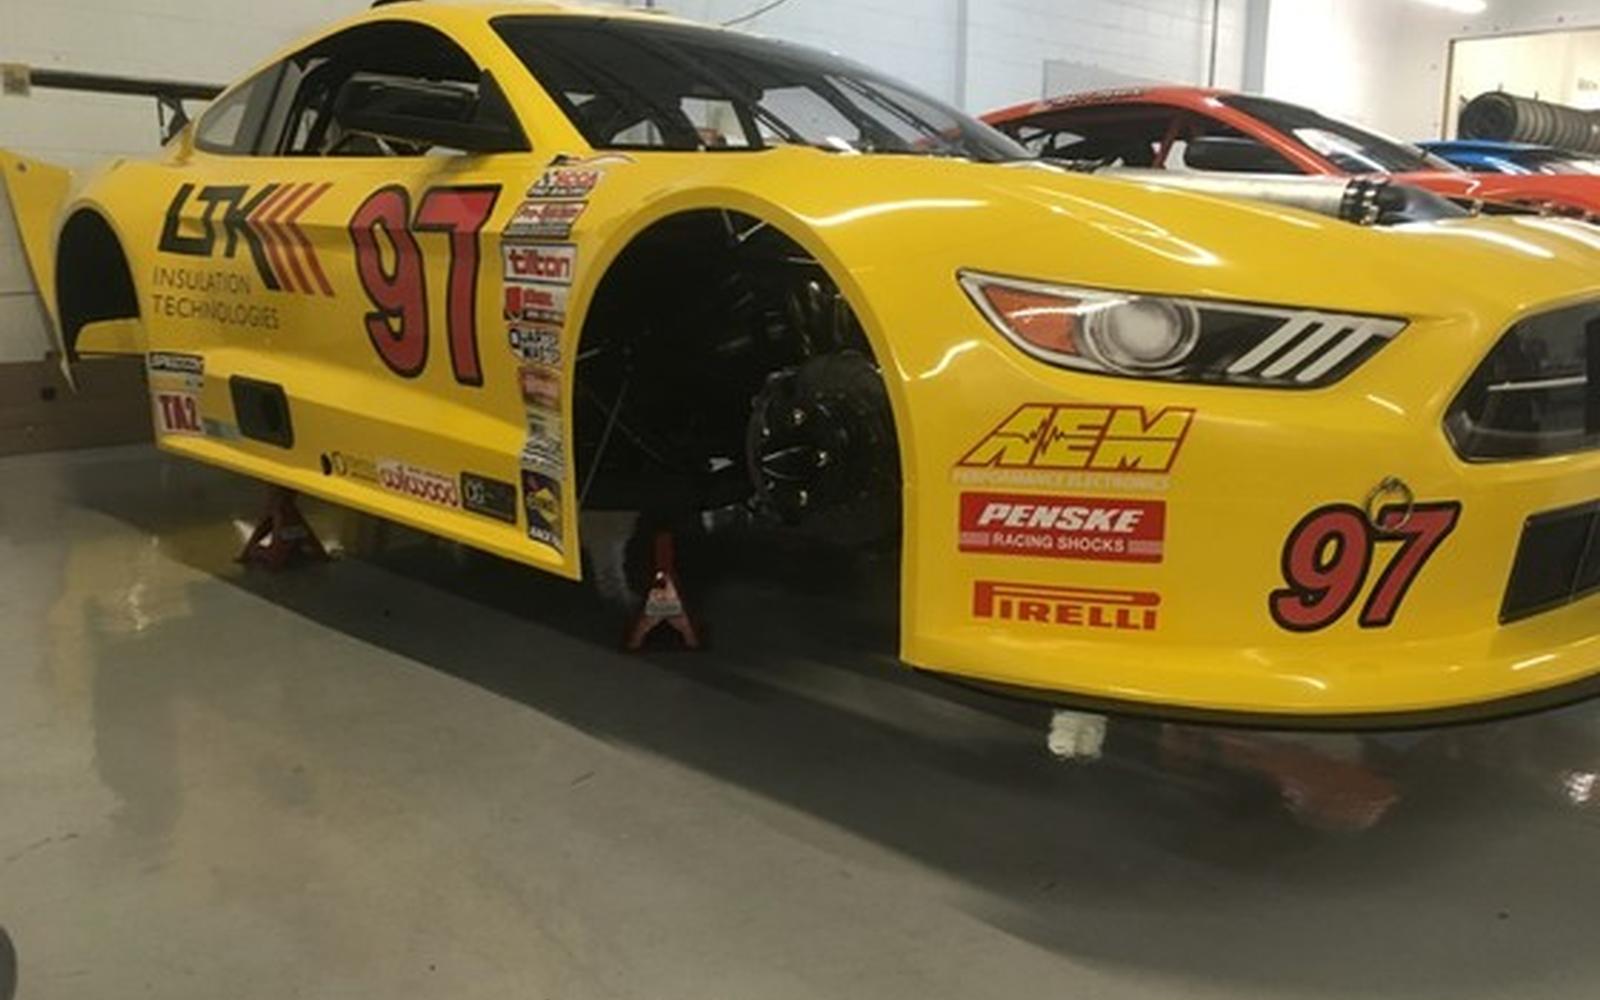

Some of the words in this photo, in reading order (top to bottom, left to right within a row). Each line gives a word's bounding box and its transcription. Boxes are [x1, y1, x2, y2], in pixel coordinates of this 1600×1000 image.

[158, 183, 283, 291] LTK
[152, 267, 251, 294] INSULATION
[508, 248, 571, 278] tilton
[348, 183, 502, 387] 97
[152, 295, 280, 330] TECHNOLOGIES
[158, 394, 202, 432] TA2
[956, 402, 1197, 474] AEM
[977, 502, 1144, 534] PENSKE
[992, 532, 1053, 550] RACING
[1057, 535, 1126, 553] SHOCKS
[1268, 500, 1463, 633] 97
[972, 580, 1161, 631] PIRELLI
